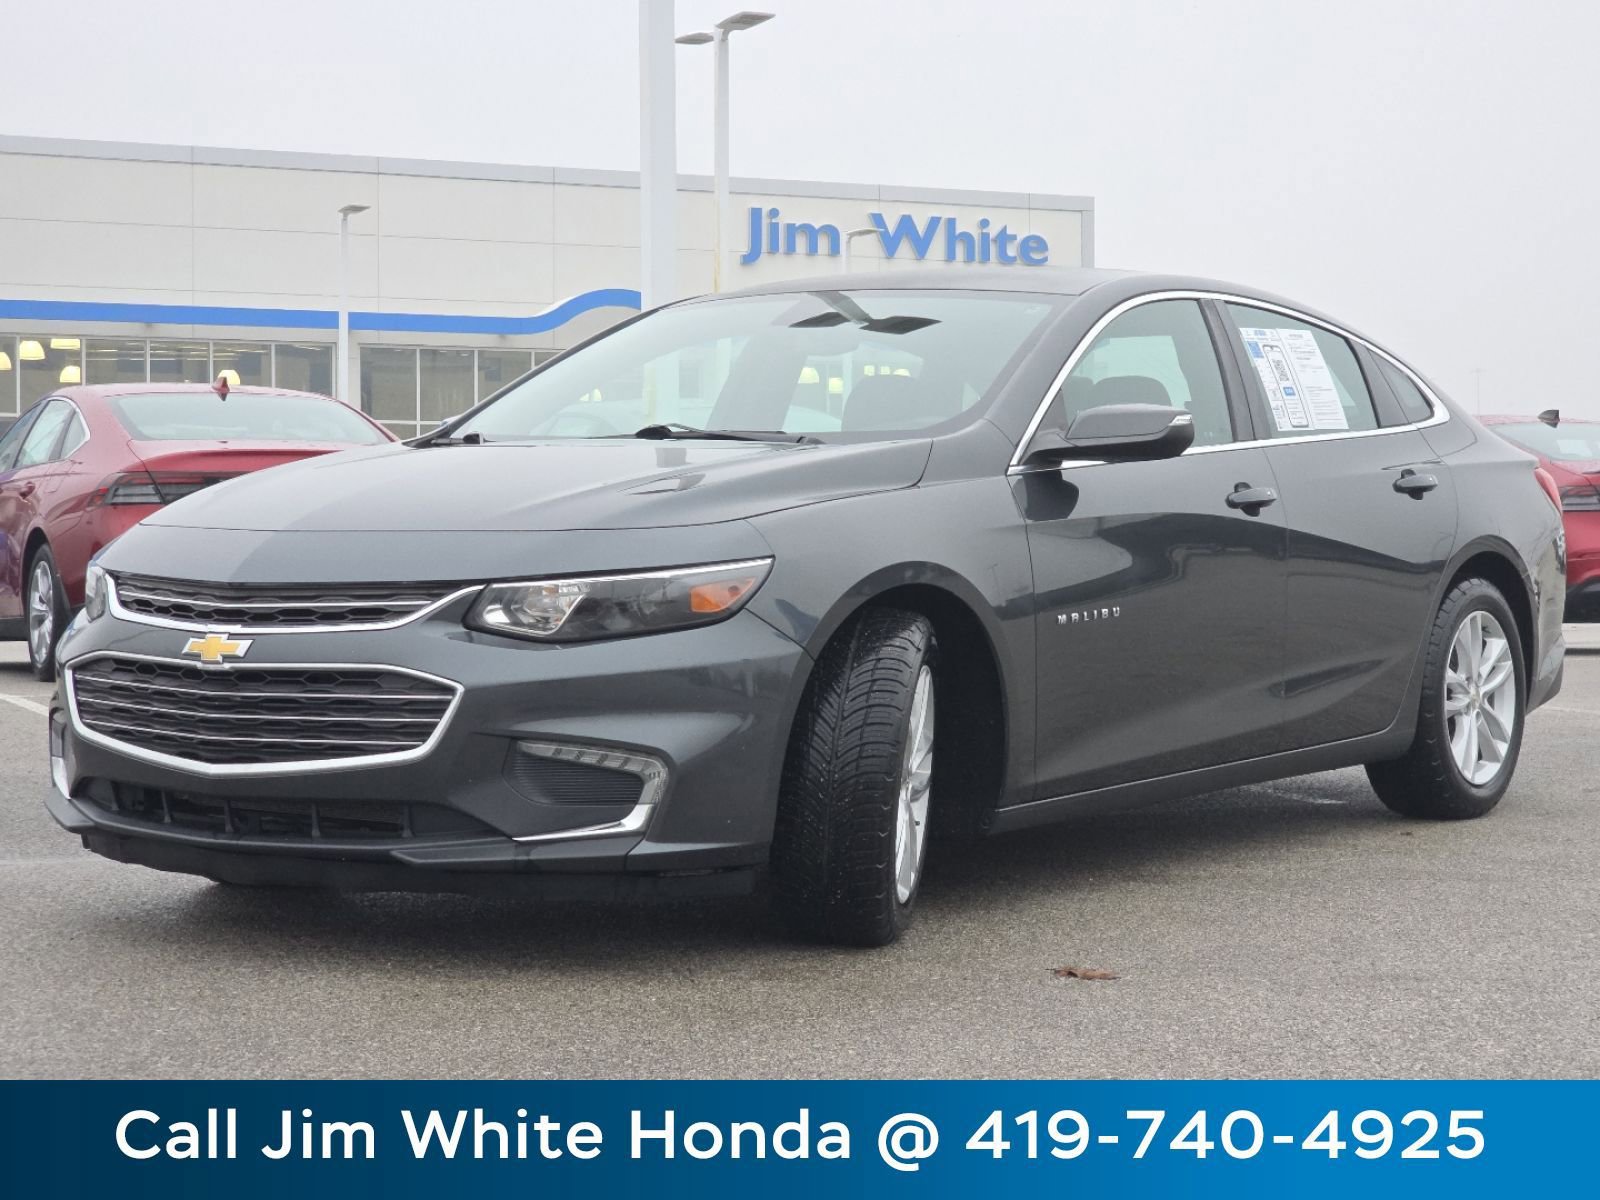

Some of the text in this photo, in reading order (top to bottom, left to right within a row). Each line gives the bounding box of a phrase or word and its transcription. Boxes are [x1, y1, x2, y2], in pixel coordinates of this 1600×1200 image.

[740, 207, 1049, 265] Jim White
[1057, 606, 1120, 625] MALIBU
